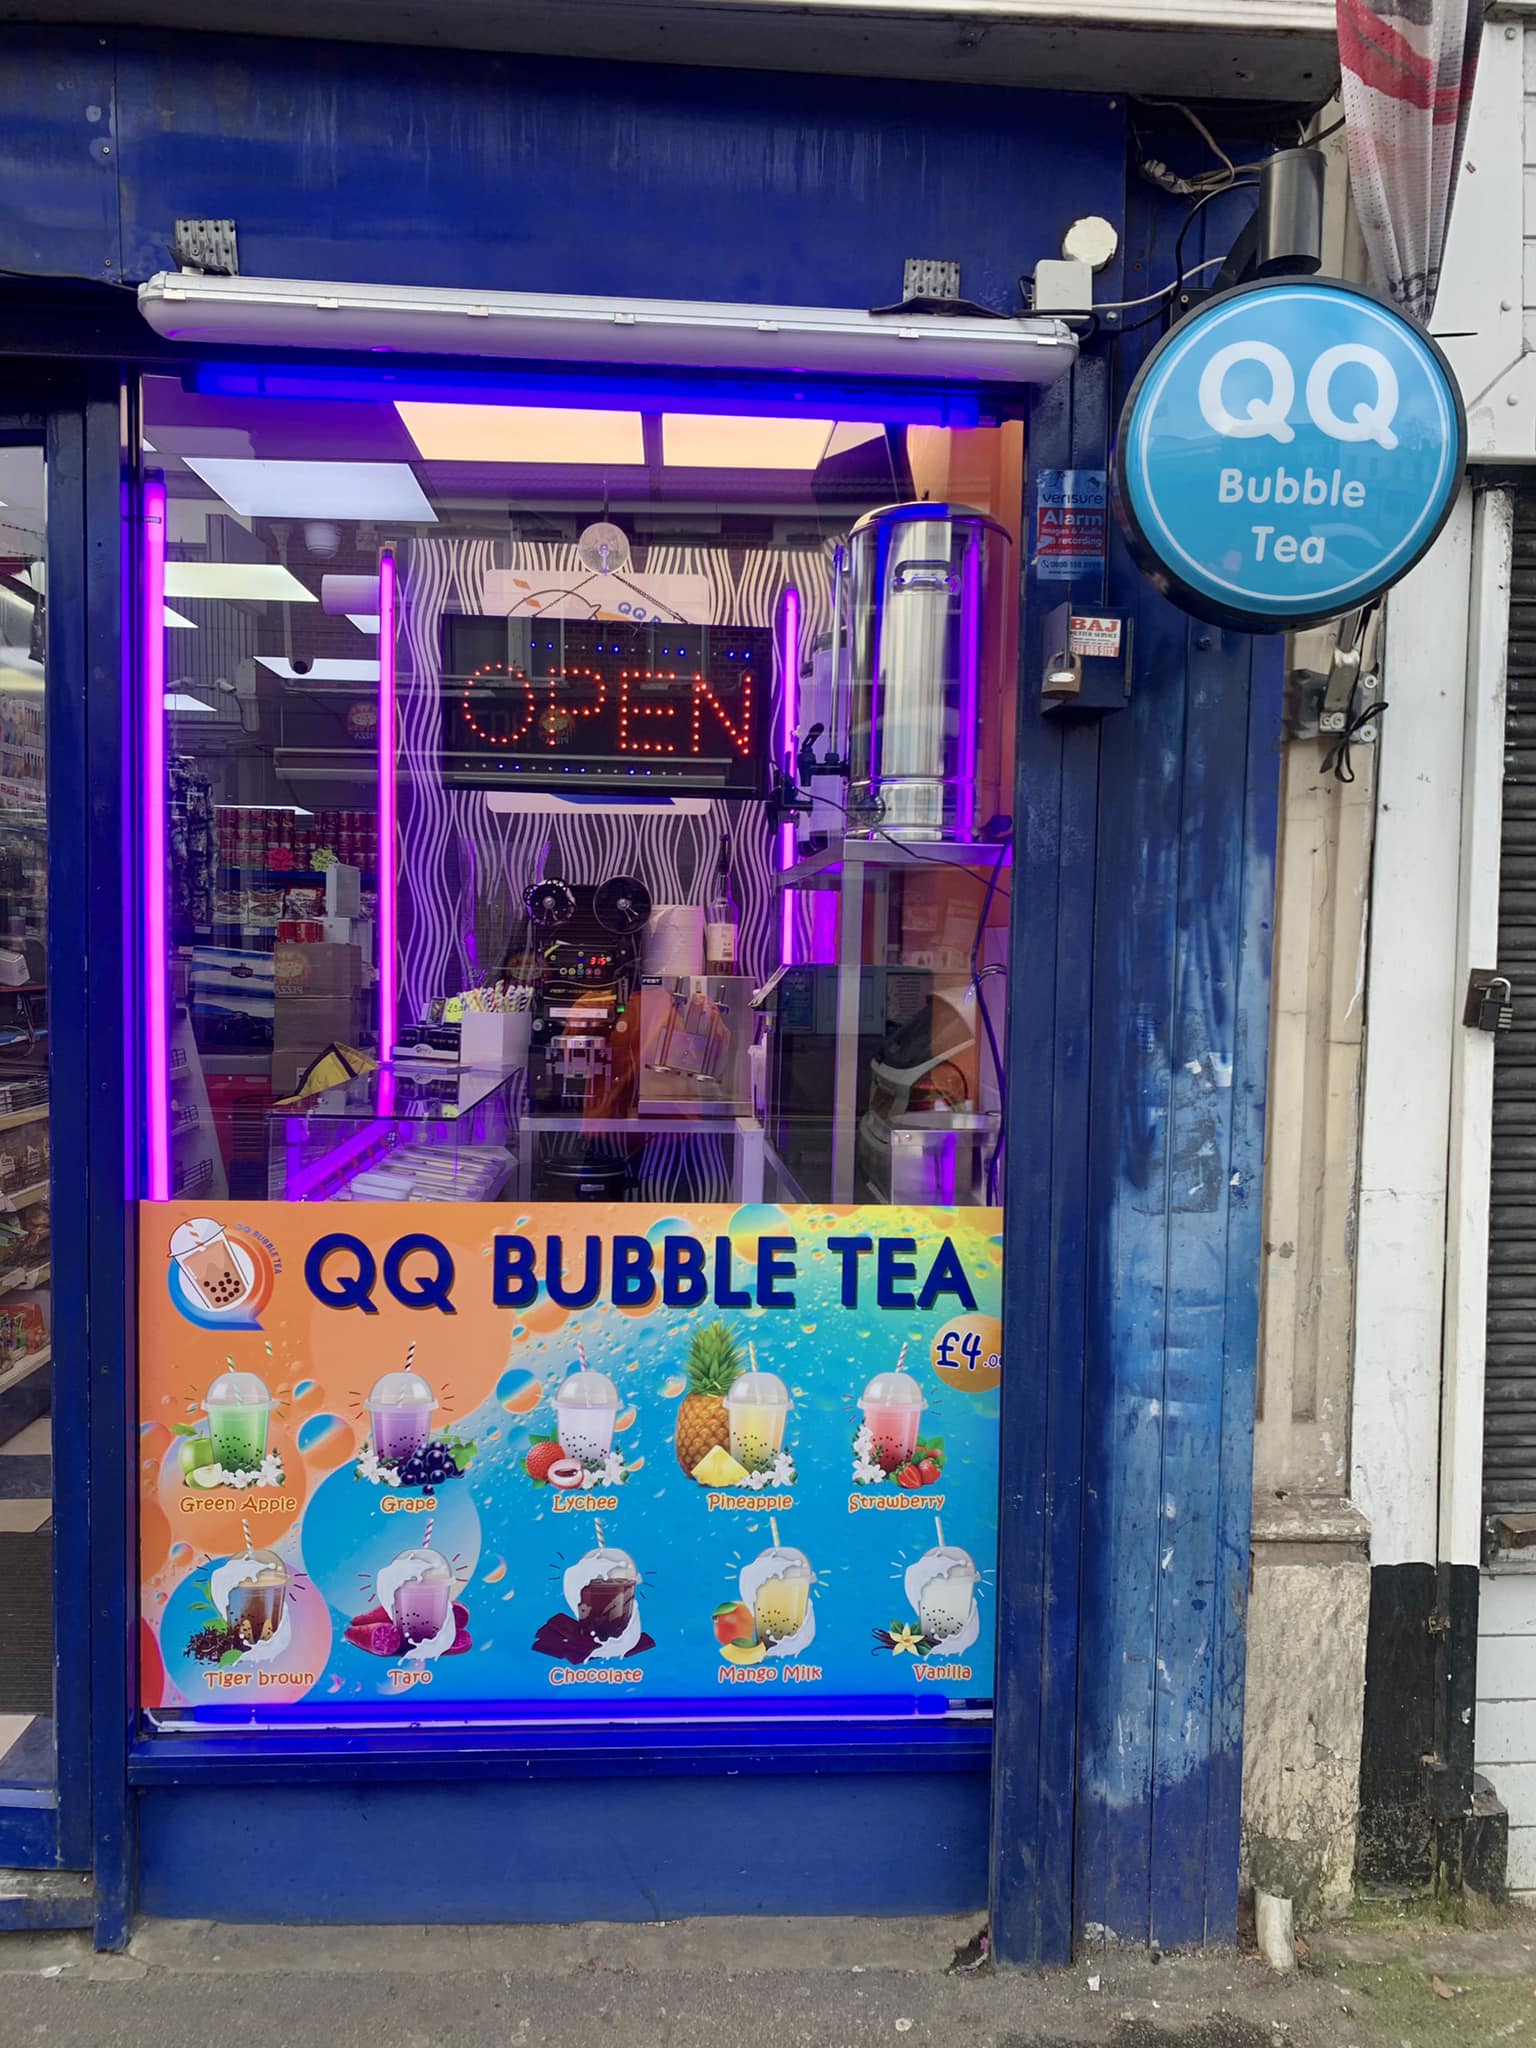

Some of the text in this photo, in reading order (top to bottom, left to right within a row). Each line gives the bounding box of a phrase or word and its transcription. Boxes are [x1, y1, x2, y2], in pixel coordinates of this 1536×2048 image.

[1197, 339, 1401, 450] QQ
[1217, 467, 1367, 508] Bubble
[1042, 493, 1104, 505] verisure
[1042, 509, 1103, 526] Alarm
[1058, 536, 1103, 548] recording
[1250, 525, 1326, 566] Tea
[1071, 618, 1119, 633] BAJ
[463, 662, 753, 756] OPEN
[304, 1232, 978, 1315] QQ BUBBLE TEA
[936, 1331, 1002, 1370] £4.0
[180, 1494, 297, 1514] Green Apple
[380, 1494, 437, 1514] Grape
[553, 1492, 618, 1513] Lychee
[707, 1492, 793, 1512] Pineapple
[848, 1492, 945, 1512] Strawberry
[203, 1668, 315, 1688] Tiger brown
[388, 1668, 433, 1686] Taro
[548, 1666, 643, 1685] Chocolate
[718, 1664, 823, 1684] Mango Milk
[912, 1664, 972, 1682] Vanilla
